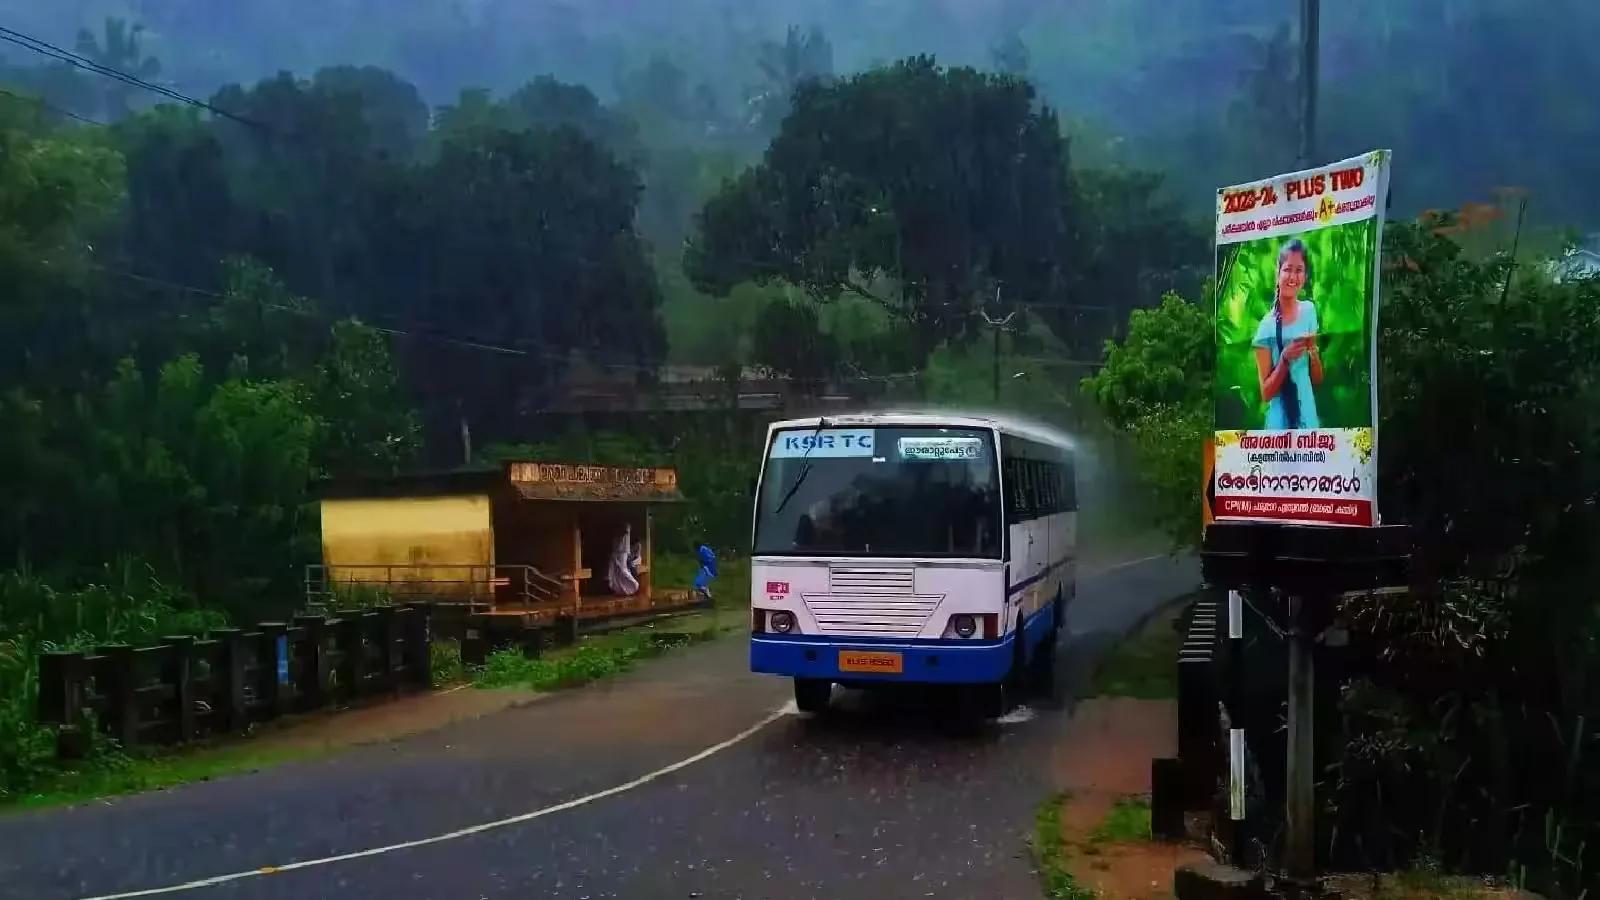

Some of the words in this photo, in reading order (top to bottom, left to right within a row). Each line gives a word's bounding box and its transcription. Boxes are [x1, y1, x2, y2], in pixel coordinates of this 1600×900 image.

[1223, 184, 1278, 214] 2023-24
[1286, 173, 1326, 201] PLUS
[1329, 166, 1364, 191] TWO
[1319, 197, 1335, 219] A+
[1296, 431, 1336, 452] ബിജു
[1217, 464, 1361, 495] അഭിനന്ദനങ്ങൾ
[1224, 500, 1252, 514] CPI(M)
